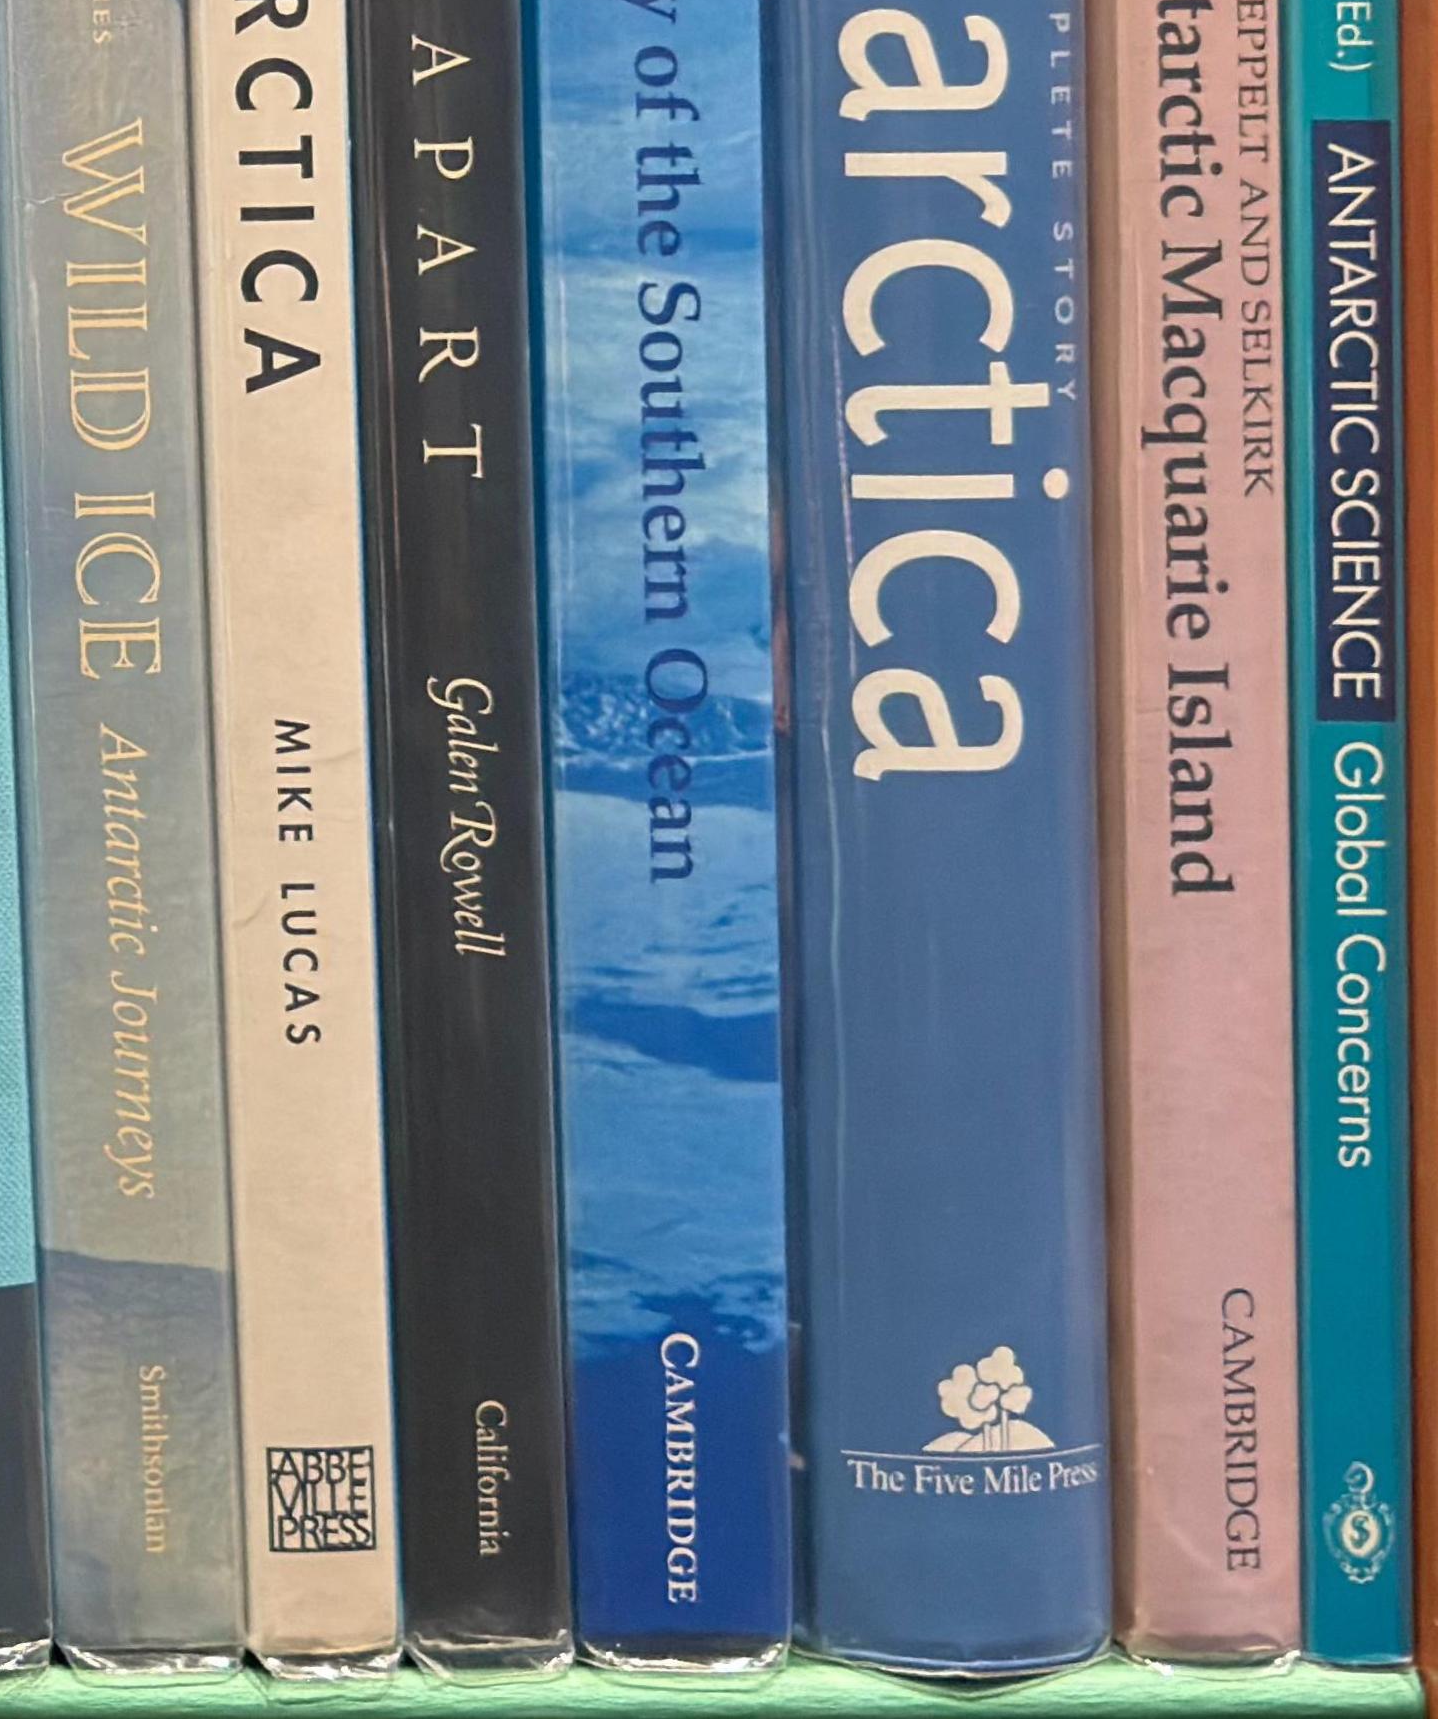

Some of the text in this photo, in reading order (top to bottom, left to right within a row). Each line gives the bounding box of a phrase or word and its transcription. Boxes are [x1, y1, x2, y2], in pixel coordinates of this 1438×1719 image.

[632, 42, 700, 123] of
[634, 138, 705, 256] the
[408, 31, 483, 481] APART
[1054, 222, 1080, 404] STORY
[1240, 177, 1272, 287] AND
[60, 115, 166, 679] WILD ICE
[638, 281, 714, 626] Southern
[1142, 239, 1228, 639] Macquarie
[1240, 299, 1276, 498] SELKIRK
[1326, 142, 1383, 700] ANTARCTIC SCIENCE
[273, 717, 323, 1047] MIKE LUCAS
[425, 676, 507, 957] Galen Rowell
[644, 646, 712, 888] Ocean
[1165, 661, 1237, 895] Island
[98, 721, 164, 1201] Antarctic Journeys
[1332, 740, 1387, 1171] Global Concerns
[136, 1362, 168, 1553] Smithsonian
[278, 1515, 371, 1550] PRESS
[473, 1398, 511, 1559] California
[657, 1330, 698, 1606] CAMBRIDGE
[847, 1458, 1098, 1495] The Five Mile Press
[1220, 1287, 1263, 1574] CAMBRIDGE
